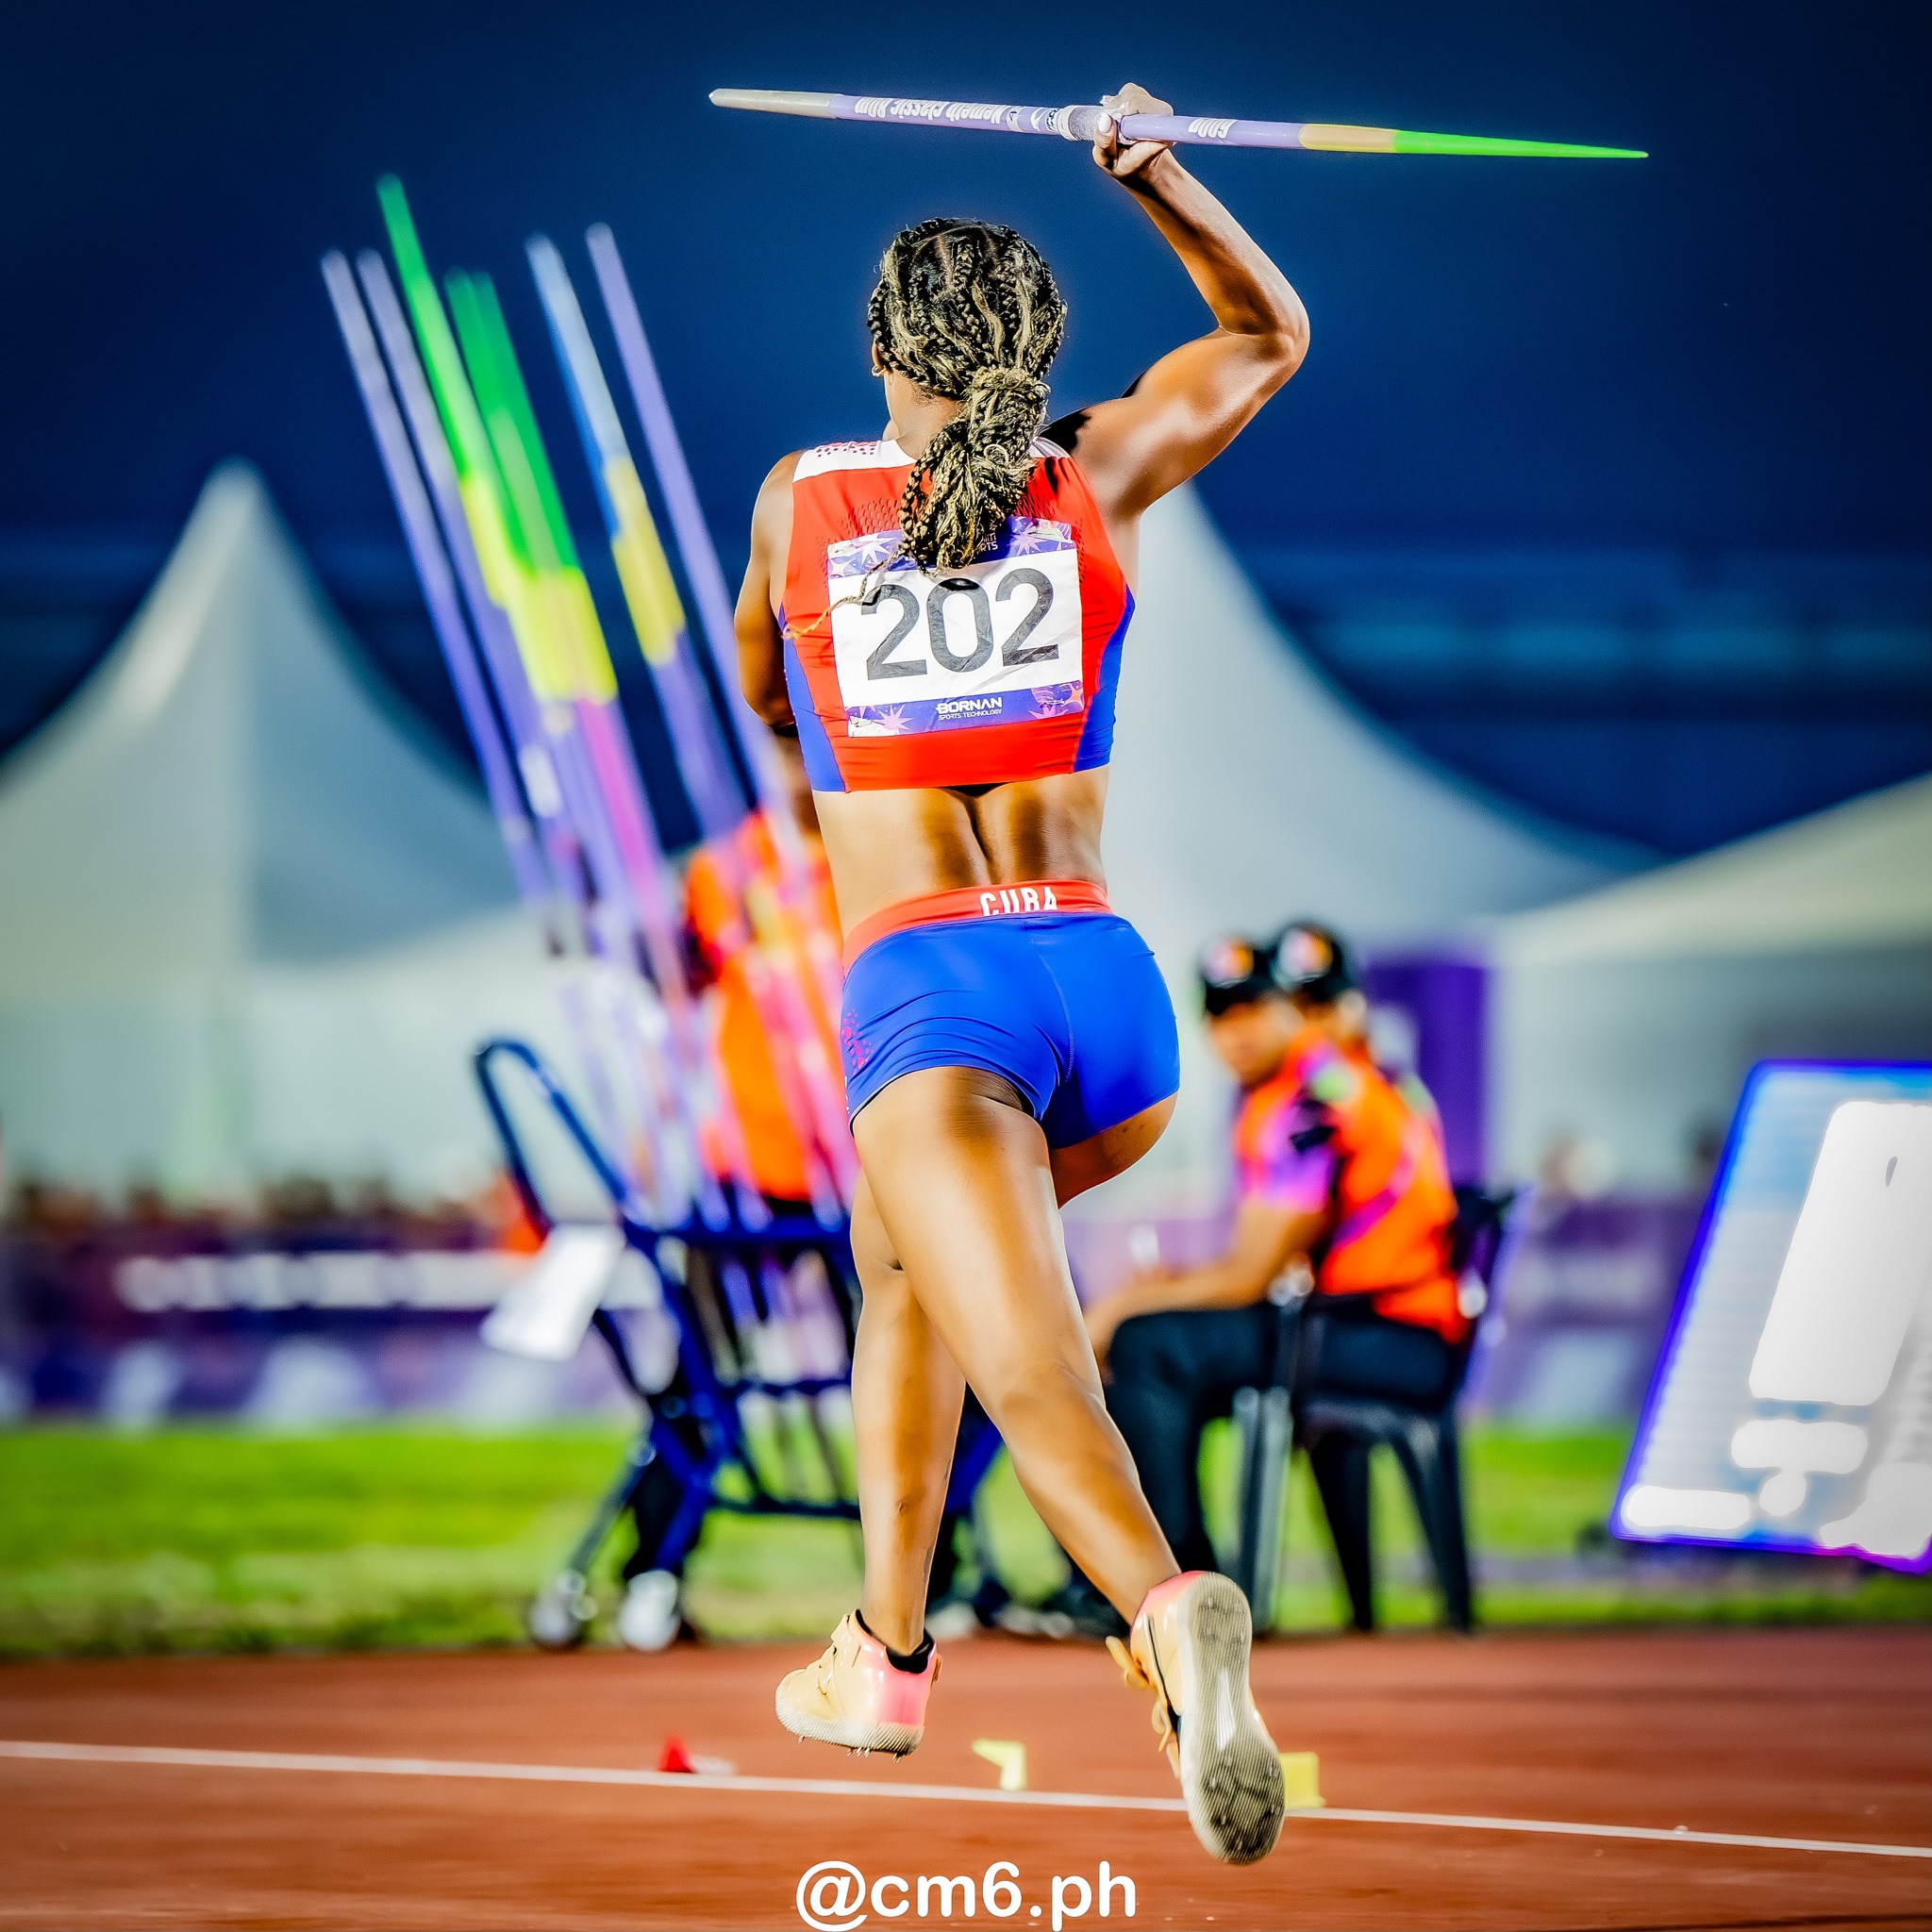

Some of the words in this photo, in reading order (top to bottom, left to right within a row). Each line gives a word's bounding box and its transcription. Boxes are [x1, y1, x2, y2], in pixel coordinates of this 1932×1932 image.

[891, 98, 949, 121] classic
[945, 101, 1010, 125] Nemeth
[860, 568, 1060, 681] 202
[935, 696, 1003, 715] BORNAN
[938, 712, 962, 721] SPORTS
[963, 708, 1003, 718] TECHNOLOGY
[979, 887, 1058, 917] CUBA
